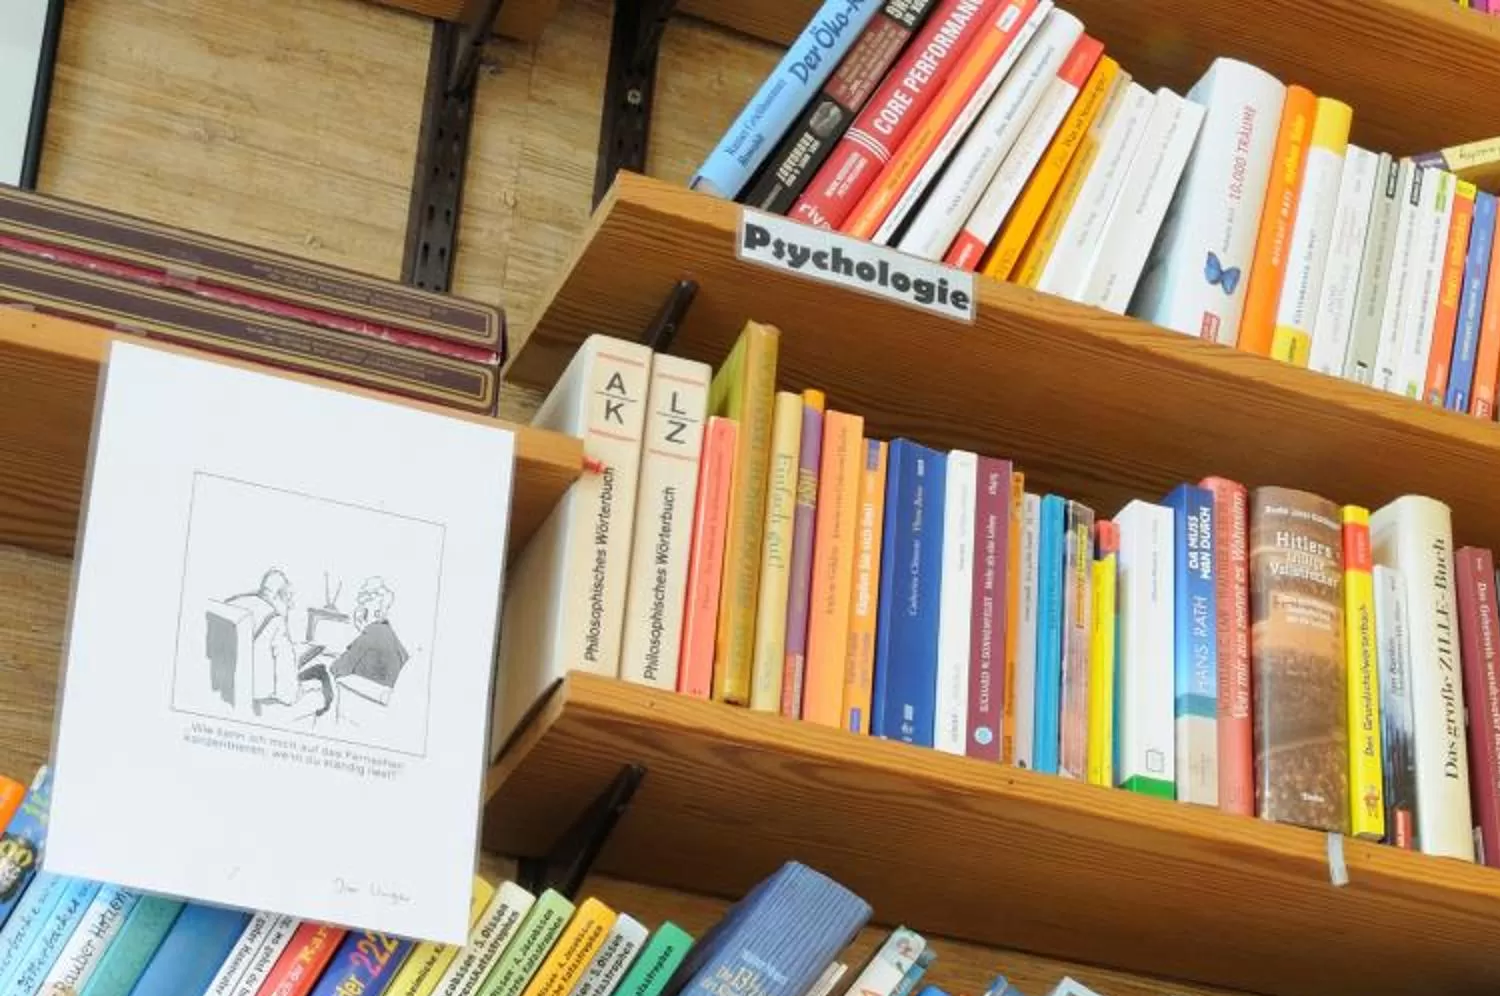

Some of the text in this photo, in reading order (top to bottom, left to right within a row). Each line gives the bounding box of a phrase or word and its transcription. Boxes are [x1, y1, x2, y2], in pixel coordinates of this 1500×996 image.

[786, 41, 829, 86] Der
[871, 89, 915, 136] CORE
[742, 221, 971, 313] Psychologie
[605, 372, 627, 396] A
[672, 392, 687, 414] L
[605, 400, 625, 425] K
[664, 420, 687, 445] Z
[1186, 514, 1198, 549] MUSS
[1198, 506, 1212, 578] MAN DURCH
[1273, 529, 1335, 558] Hitlers
[579, 465, 618, 662] Philosophisches Wörterbuch
[638, 484, 679, 681] Philosophisches Wörterbuch
[1433, 537, 1459, 779] Das große ZILLE-Buch
[517, 913, 570, 977] Katastrophen
[556, 922, 609, 985] Katastrophen
